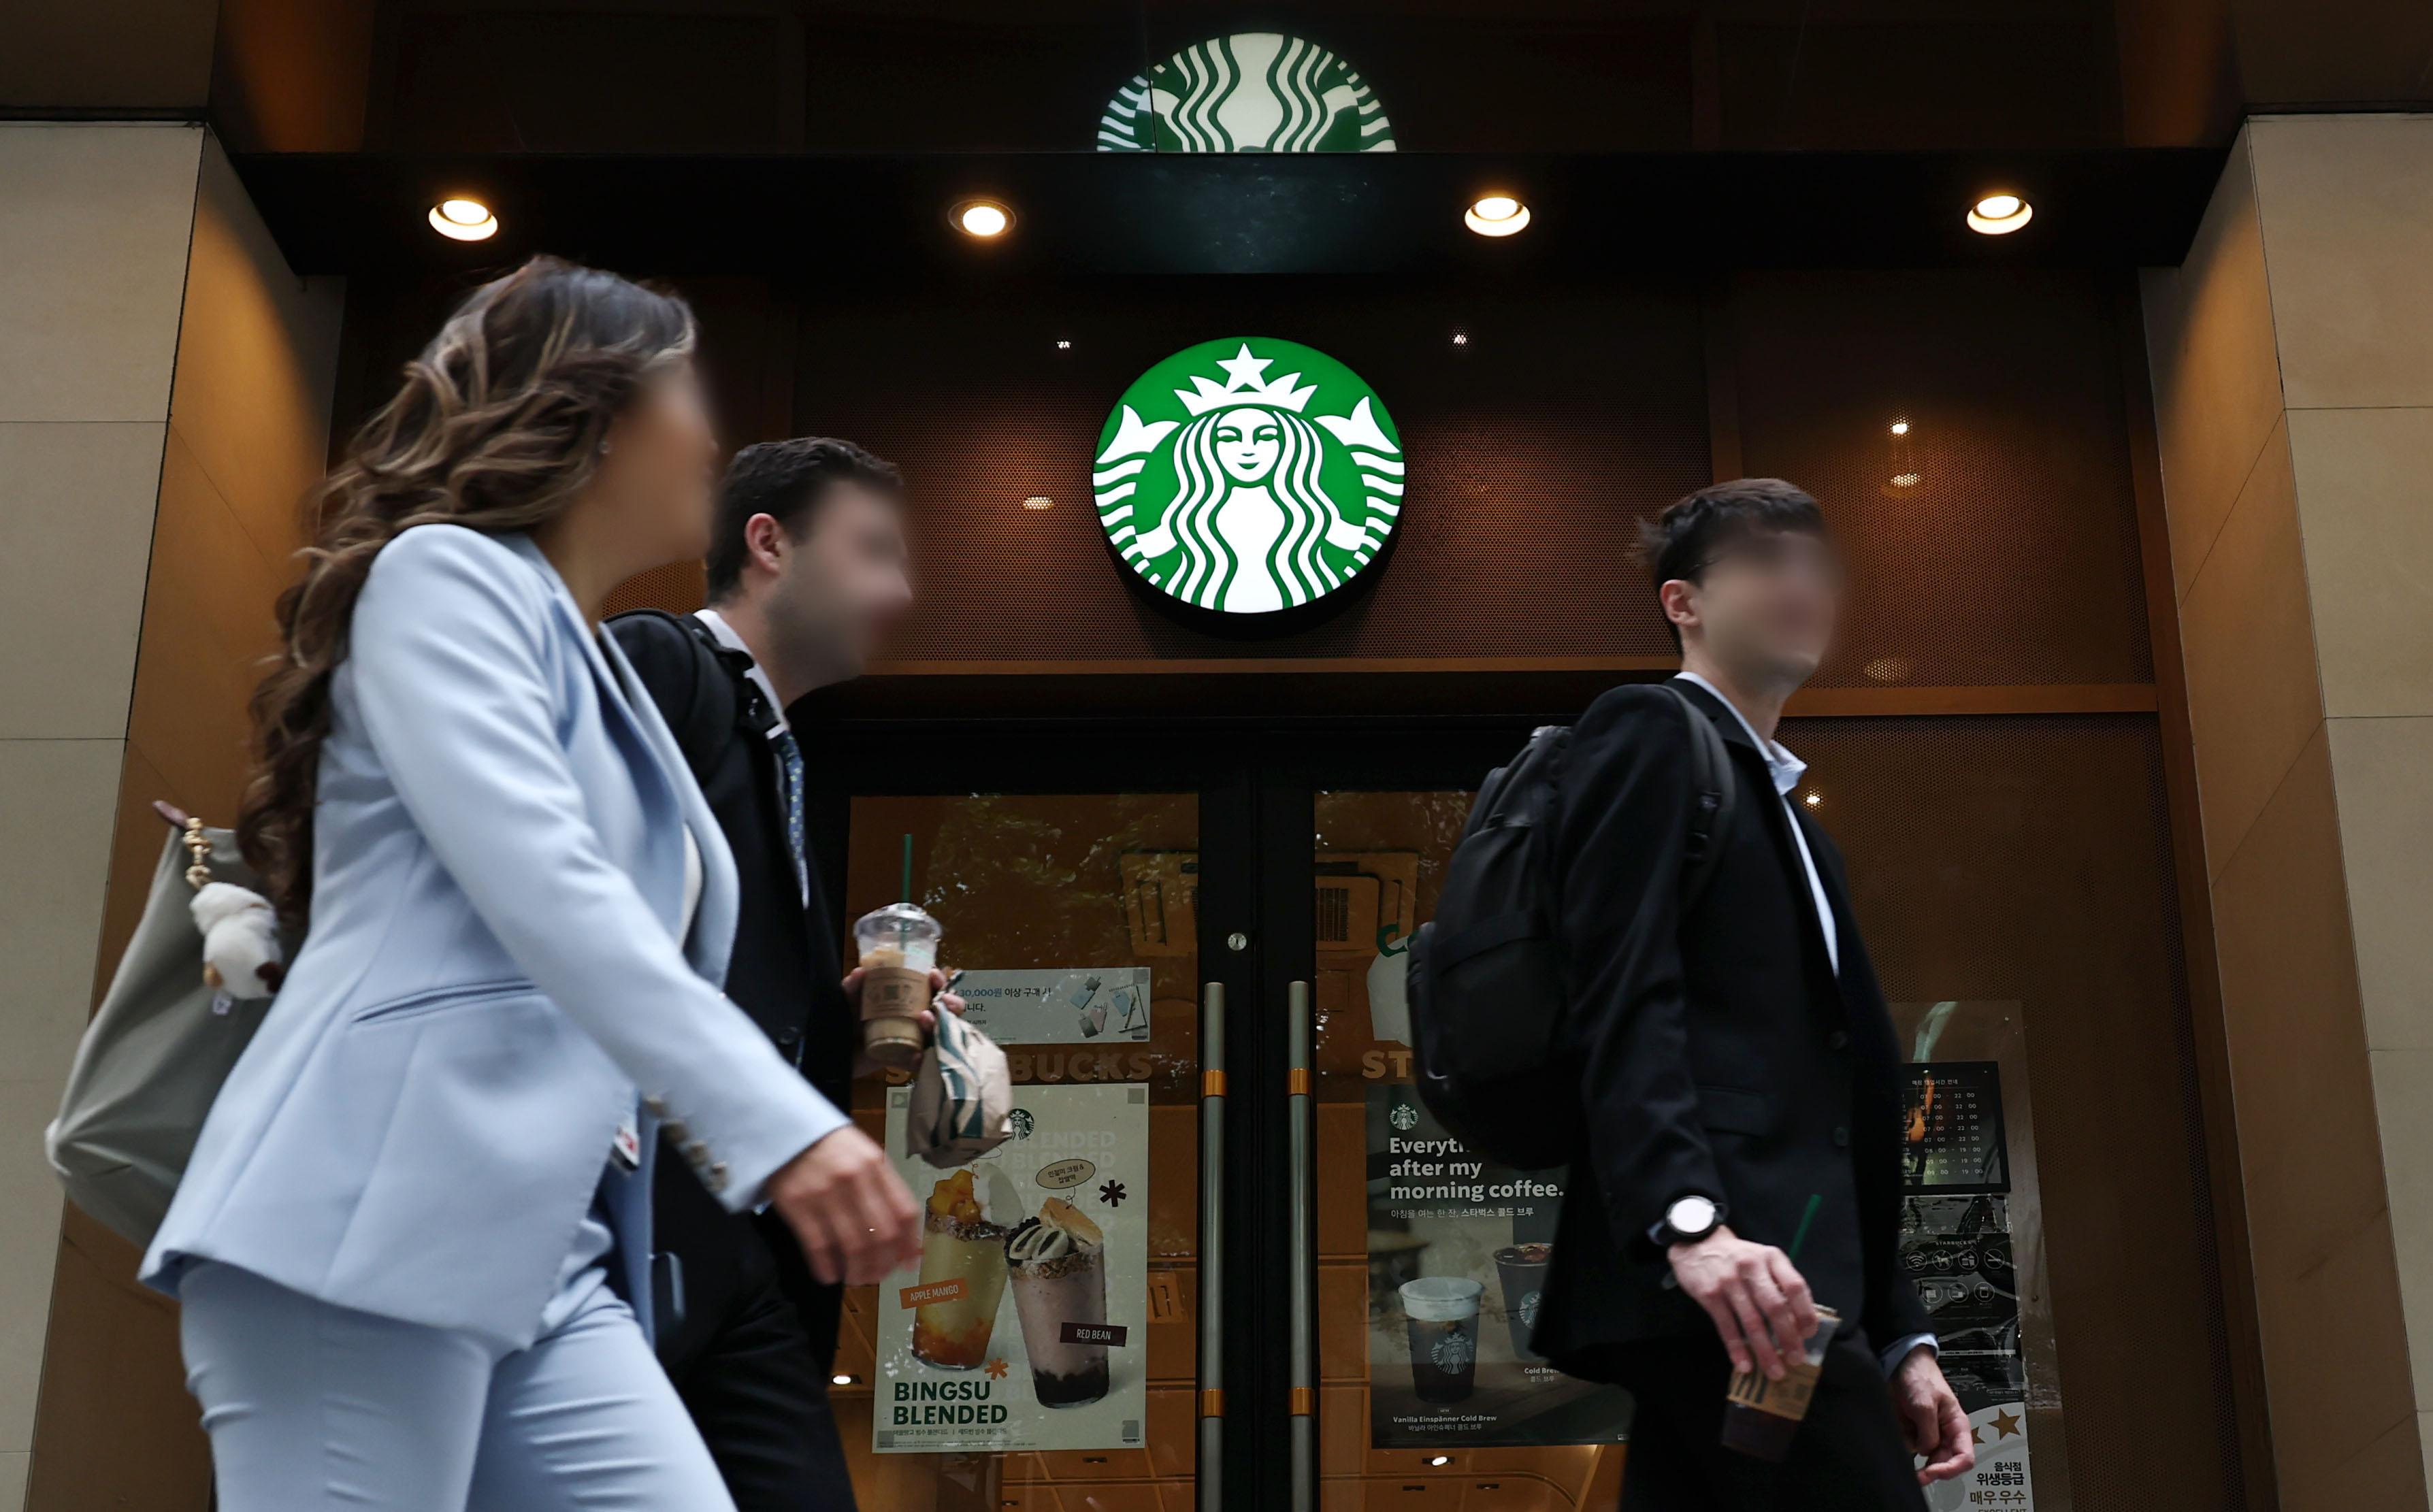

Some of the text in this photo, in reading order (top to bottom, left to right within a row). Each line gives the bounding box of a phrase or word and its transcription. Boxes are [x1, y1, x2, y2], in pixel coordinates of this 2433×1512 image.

[1005, 988, 1021, 997] 이상
[1023, 988, 1040, 997] 구매
[964, 1004, 986, 1012] 니다.
[886, 1052, 1152, 1083] SBUCKS
[1390, 1137, 1470, 1157] Everyt
[1390, 1160, 1482, 1179] after my
[1390, 1180, 1564, 1202] morning coffee.
[1390, 1207, 1534, 1219] 아침을 여는 한 잔, 스타벅스 콜드 브루
[910, 1284, 958, 1301] APPLE MANGO
[1077, 1328, 1111, 1340] RED BEAN
[894, 1381, 990, 1401] BINGSU
[894, 1405, 1007, 1425] BLENDED
[1419, 1415, 1459, 1424] Einspänner
[1994, 1462, 2021, 1472] 음식점
[1976, 1473, 2024, 1486] 위생등급
[1970, 1490, 2026, 1505] 매우 우수
